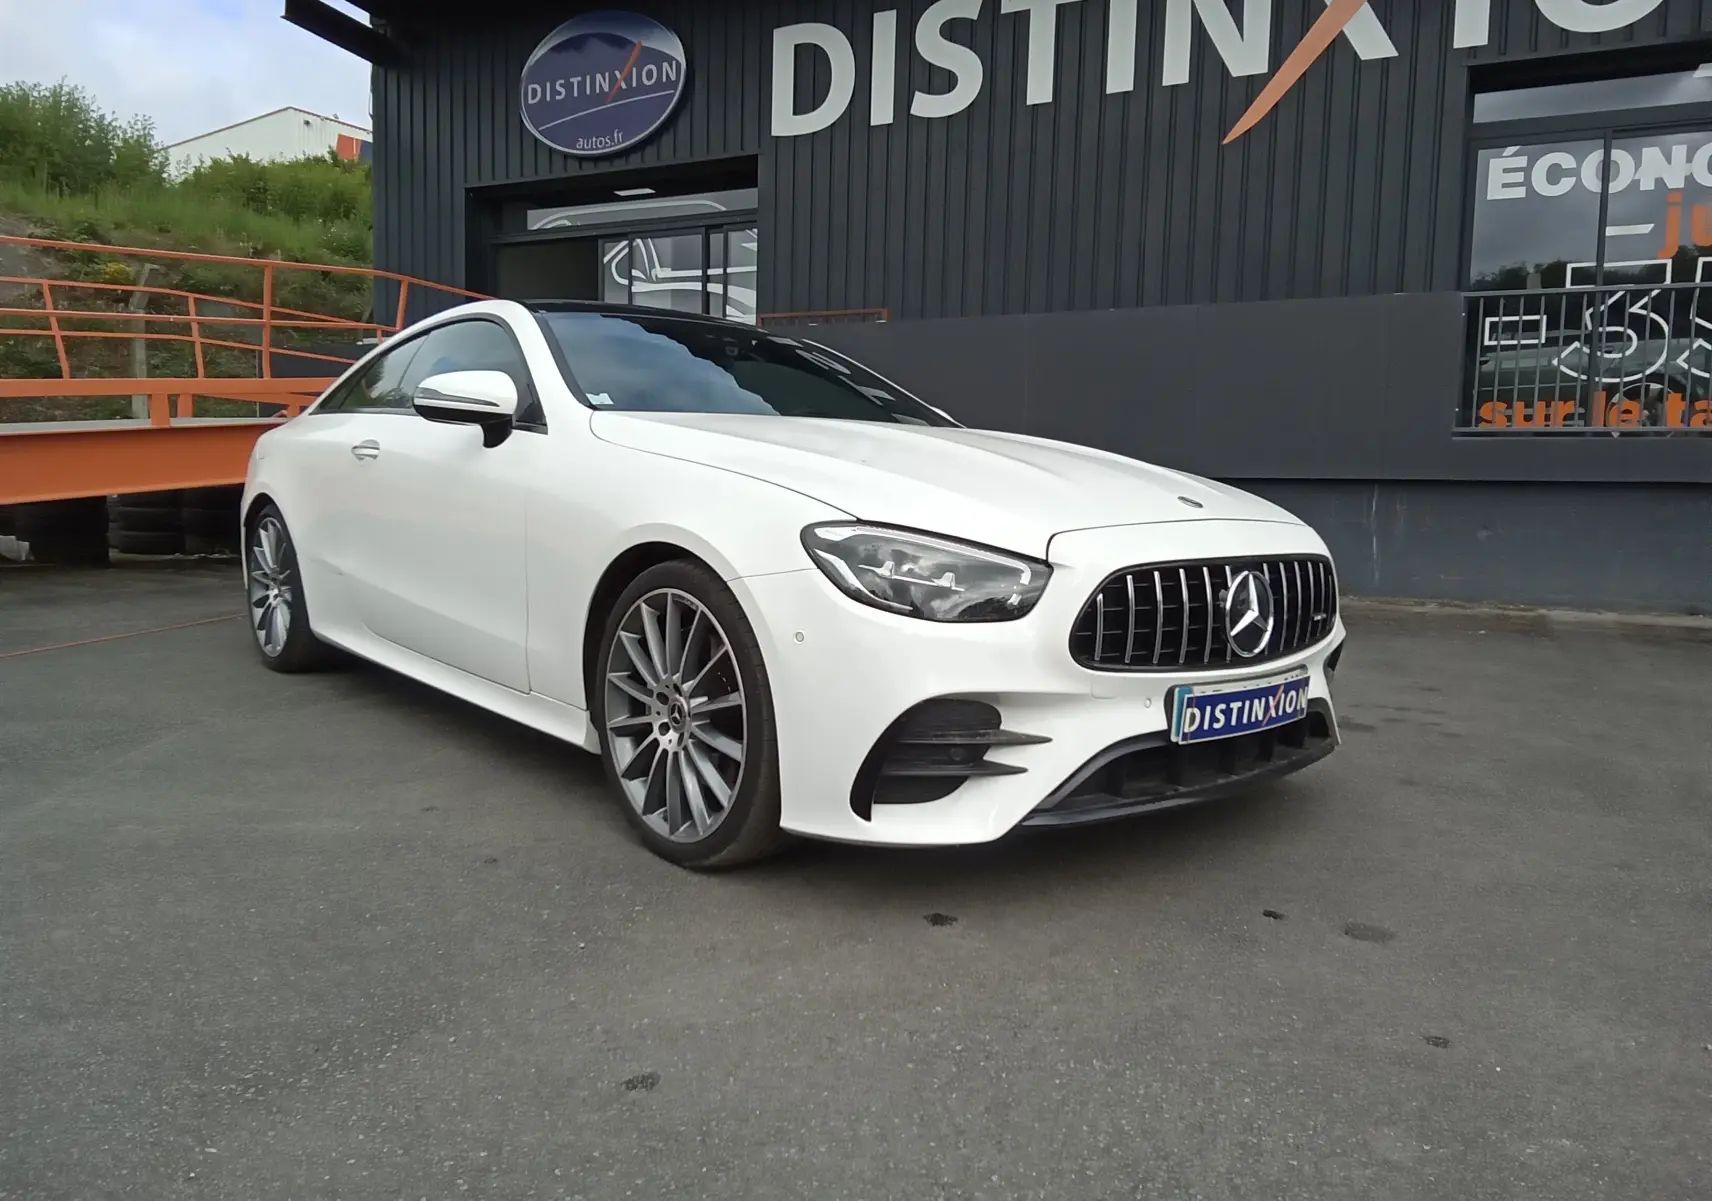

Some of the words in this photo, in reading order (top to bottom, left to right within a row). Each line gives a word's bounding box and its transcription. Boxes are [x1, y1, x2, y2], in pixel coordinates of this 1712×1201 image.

[528, 60, 677, 104] DISTINXION
[771, 0, 1666, 143] DISTINX
[576, 129, 623, 149] autos.fr
[1479, 400, 1576, 428] sur
[1592, 391, 1642, 428] le
[1184, 686, 1308, 733] DISTINXION
